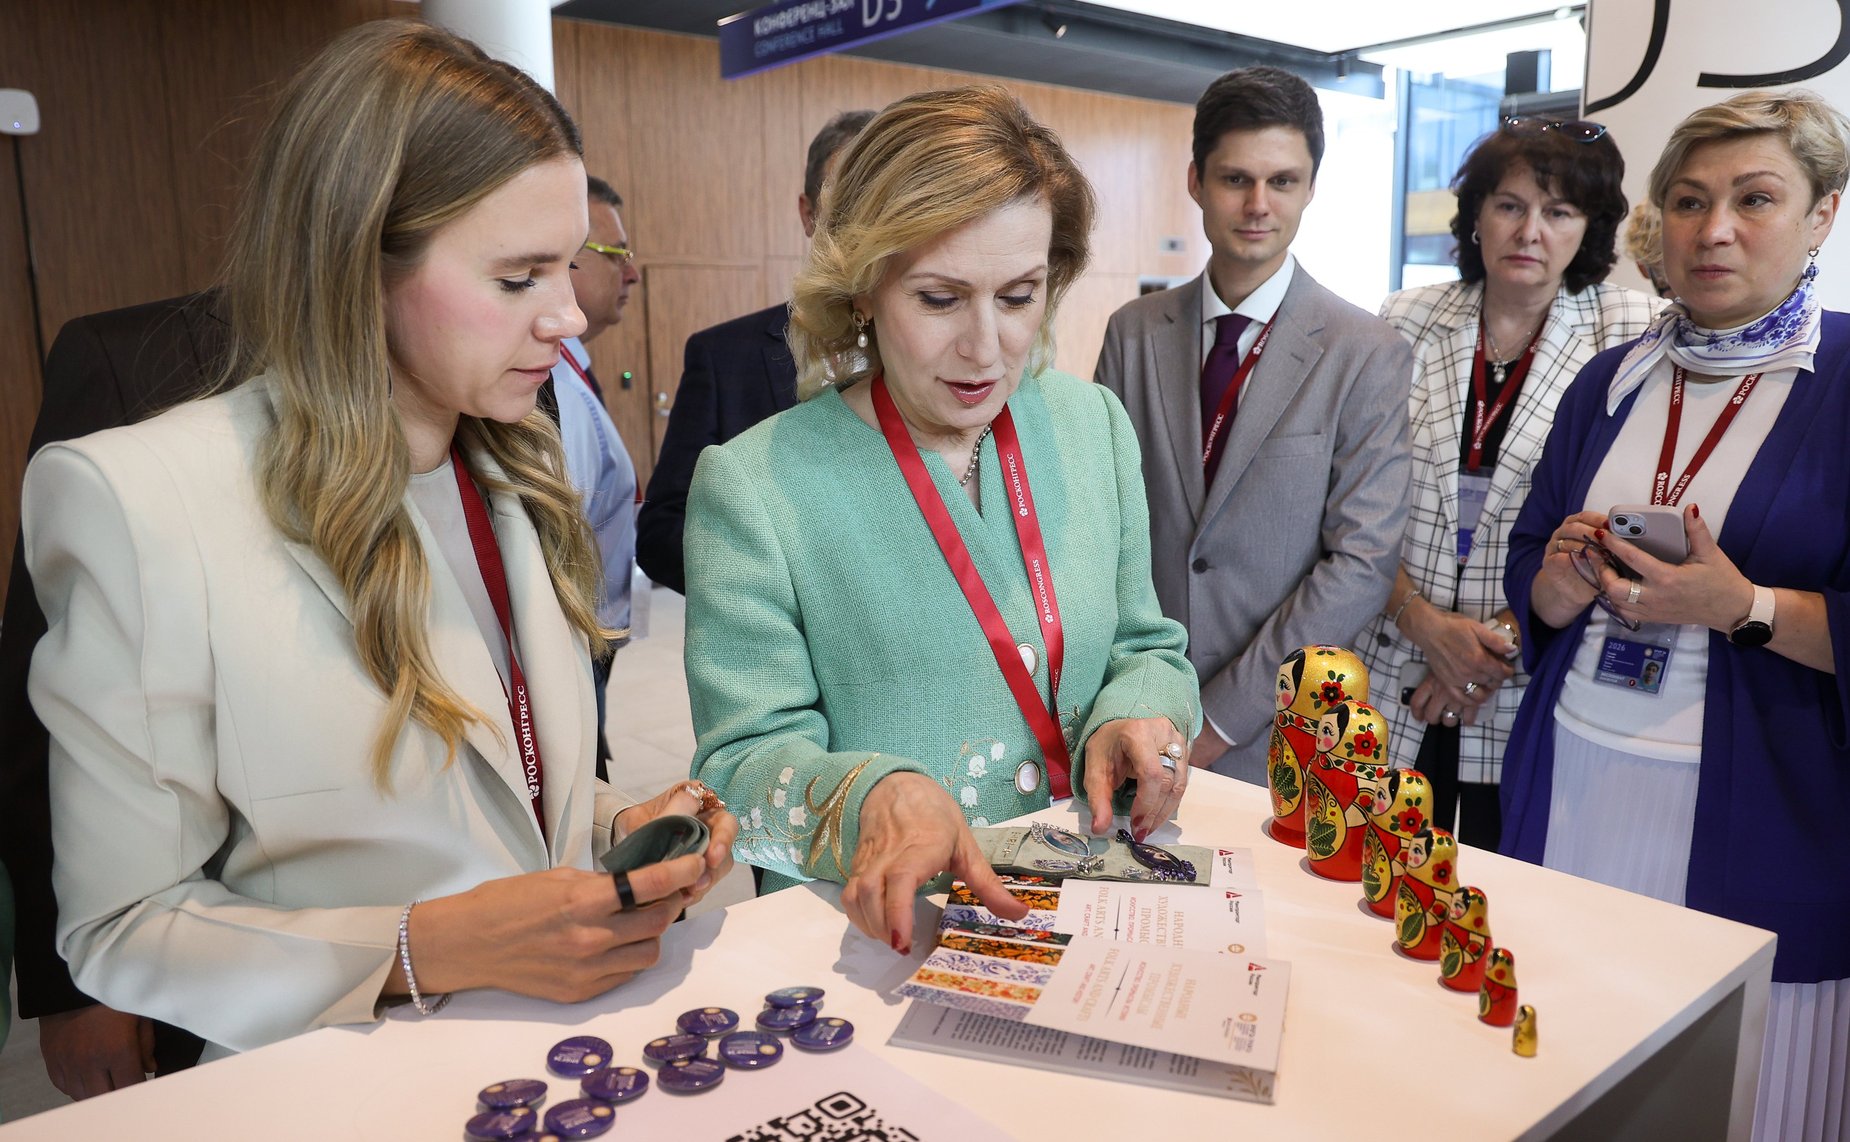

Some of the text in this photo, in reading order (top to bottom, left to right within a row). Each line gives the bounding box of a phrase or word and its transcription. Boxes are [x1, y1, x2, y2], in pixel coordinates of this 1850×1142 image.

[1006, 453, 1026, 508] РОСКОНГРЕСС
[1033, 559, 1051, 614] ROSCONGRESS
[517, 685, 538, 784] РОСКОНГРЕСС
[1095, 904, 1107, 925] ARTS
[1097, 886, 1109, 903] FOLK
[1156, 895, 1169, 947] ХУДОЖЕСТВ
[1172, 911, 1185, 949] НАРОДН
